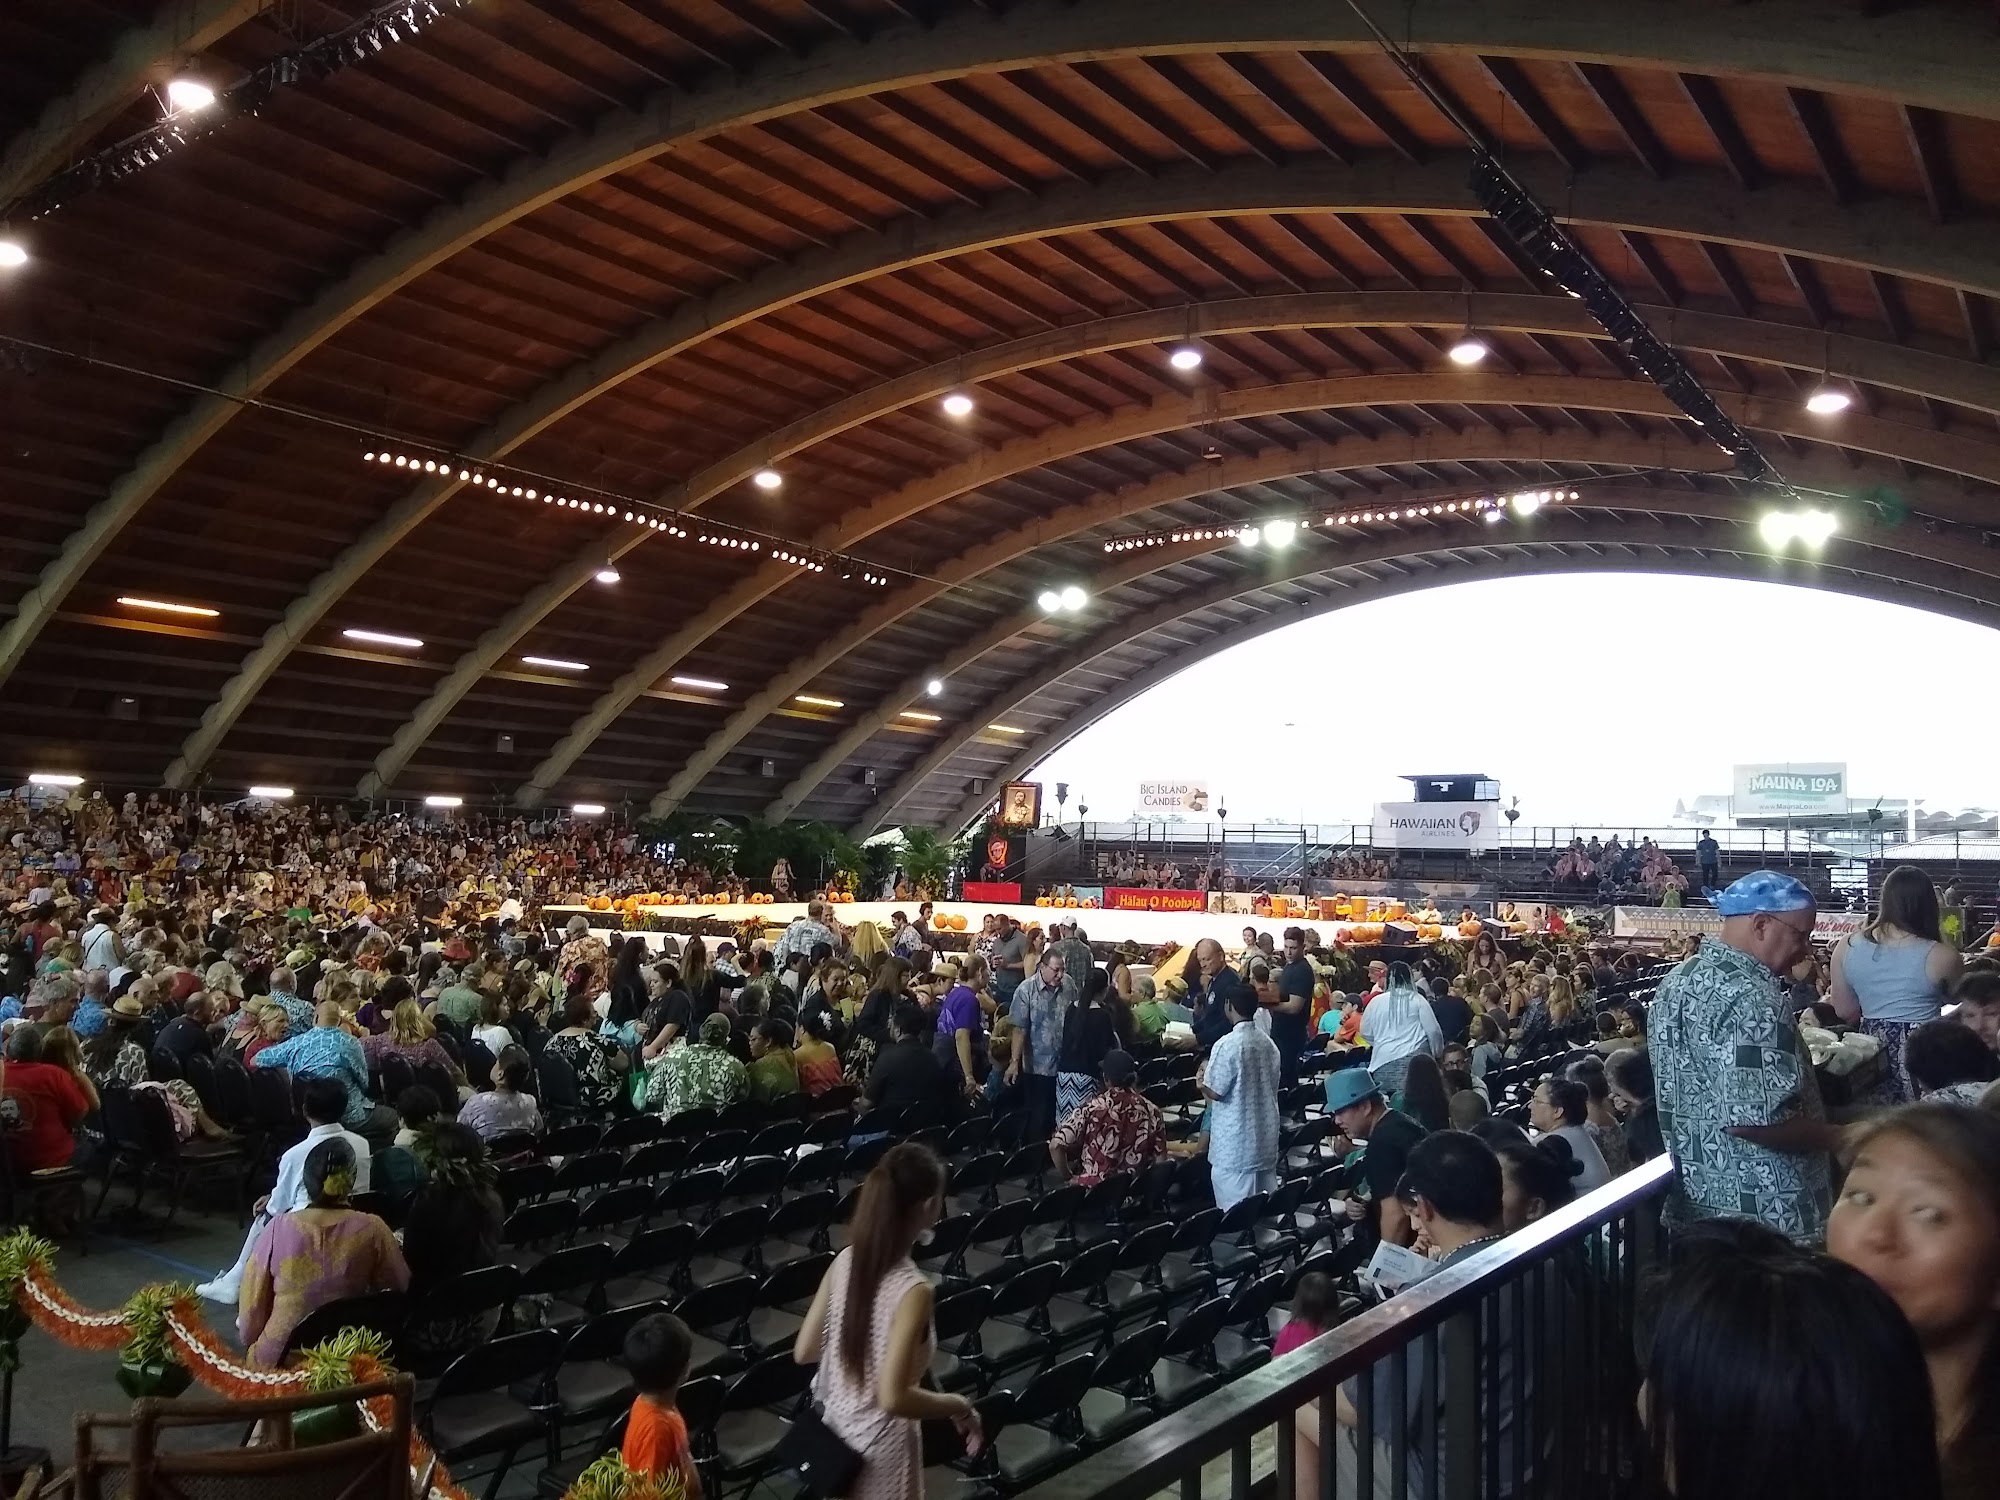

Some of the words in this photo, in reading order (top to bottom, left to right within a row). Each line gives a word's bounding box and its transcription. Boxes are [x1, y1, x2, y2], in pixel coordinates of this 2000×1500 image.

[1750, 776, 1807, 791] MAUNA
[1810, 778, 1838, 791] LOA
[1157, 784, 1188, 794] ISLAND
[1144, 795, 1181, 805] CANDIES
[1390, 818, 1456, 829] HAWAIIAN
